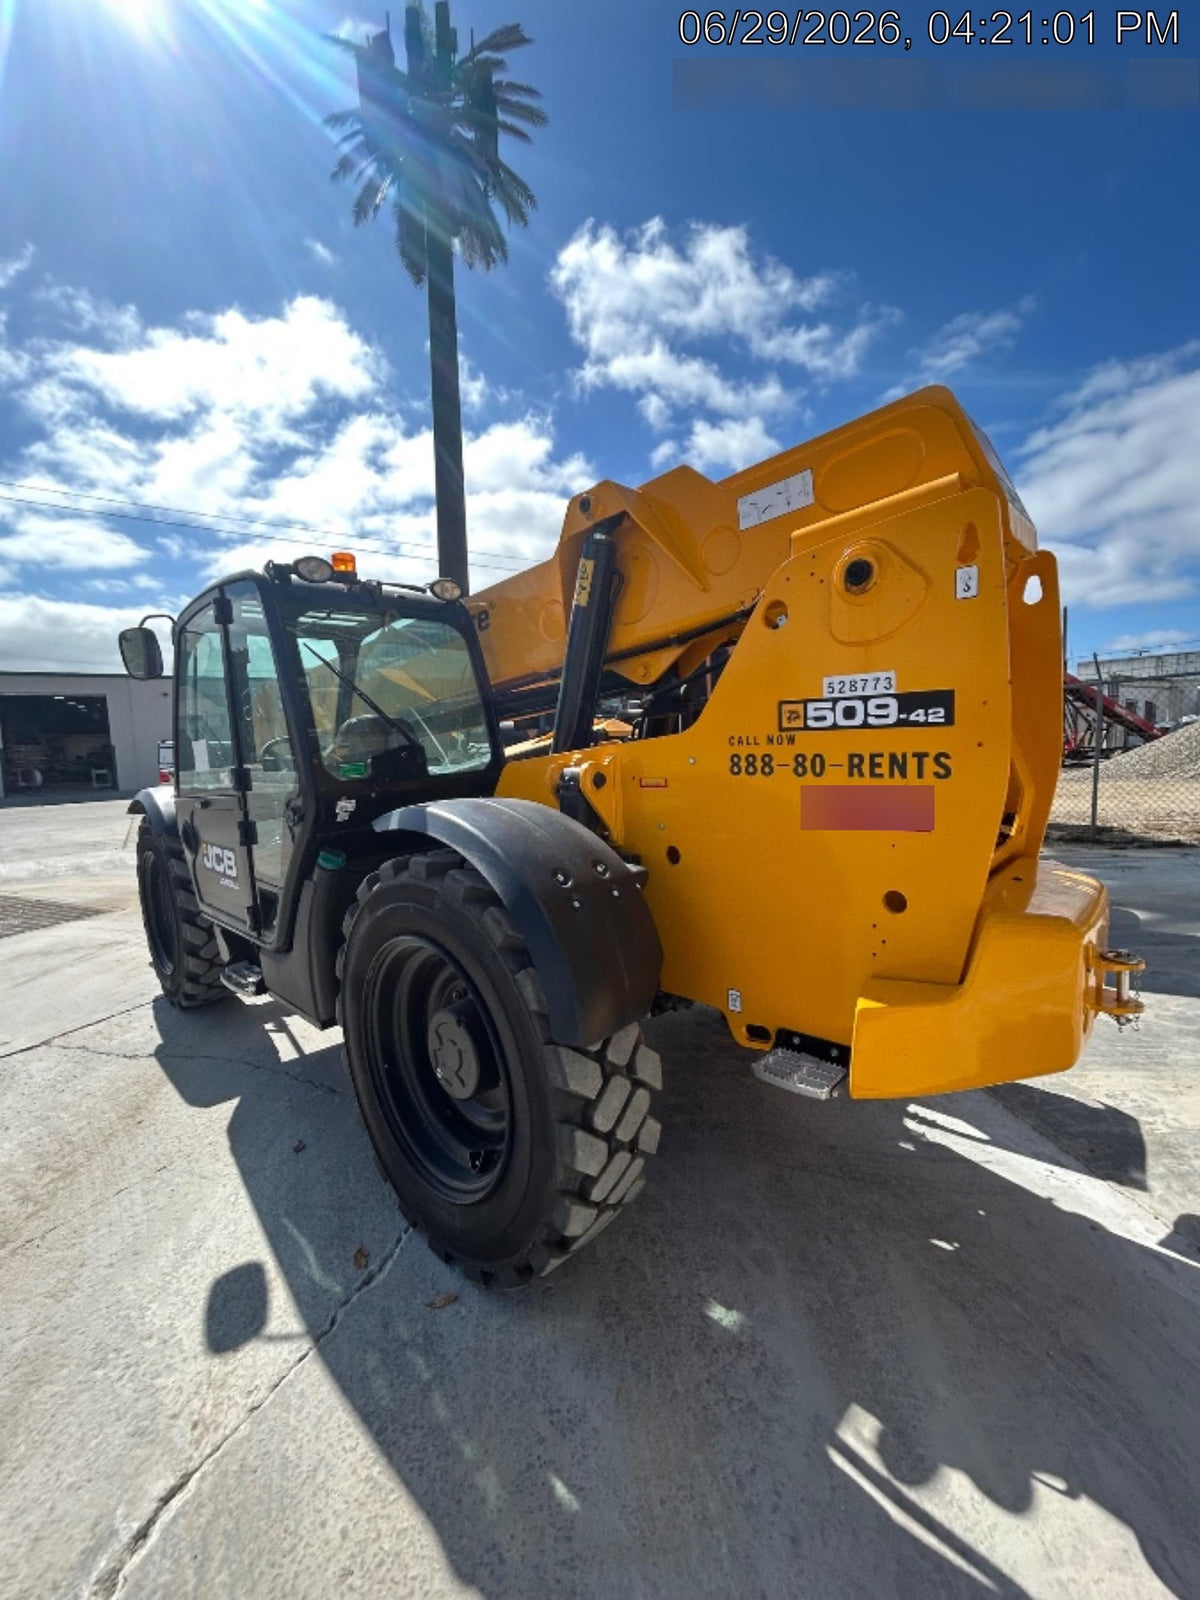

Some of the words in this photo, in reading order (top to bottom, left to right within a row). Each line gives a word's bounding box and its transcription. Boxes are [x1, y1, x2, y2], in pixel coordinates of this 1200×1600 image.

[827, 676, 893, 694] 528773
[806, 697, 945, 728] 509-42
[728, 735, 760, 746] CALL
[766, 734, 796, 745] NOW
[729, 752, 952, 779] 888-80-RENTS
[203, 844, 237, 877] JCB
